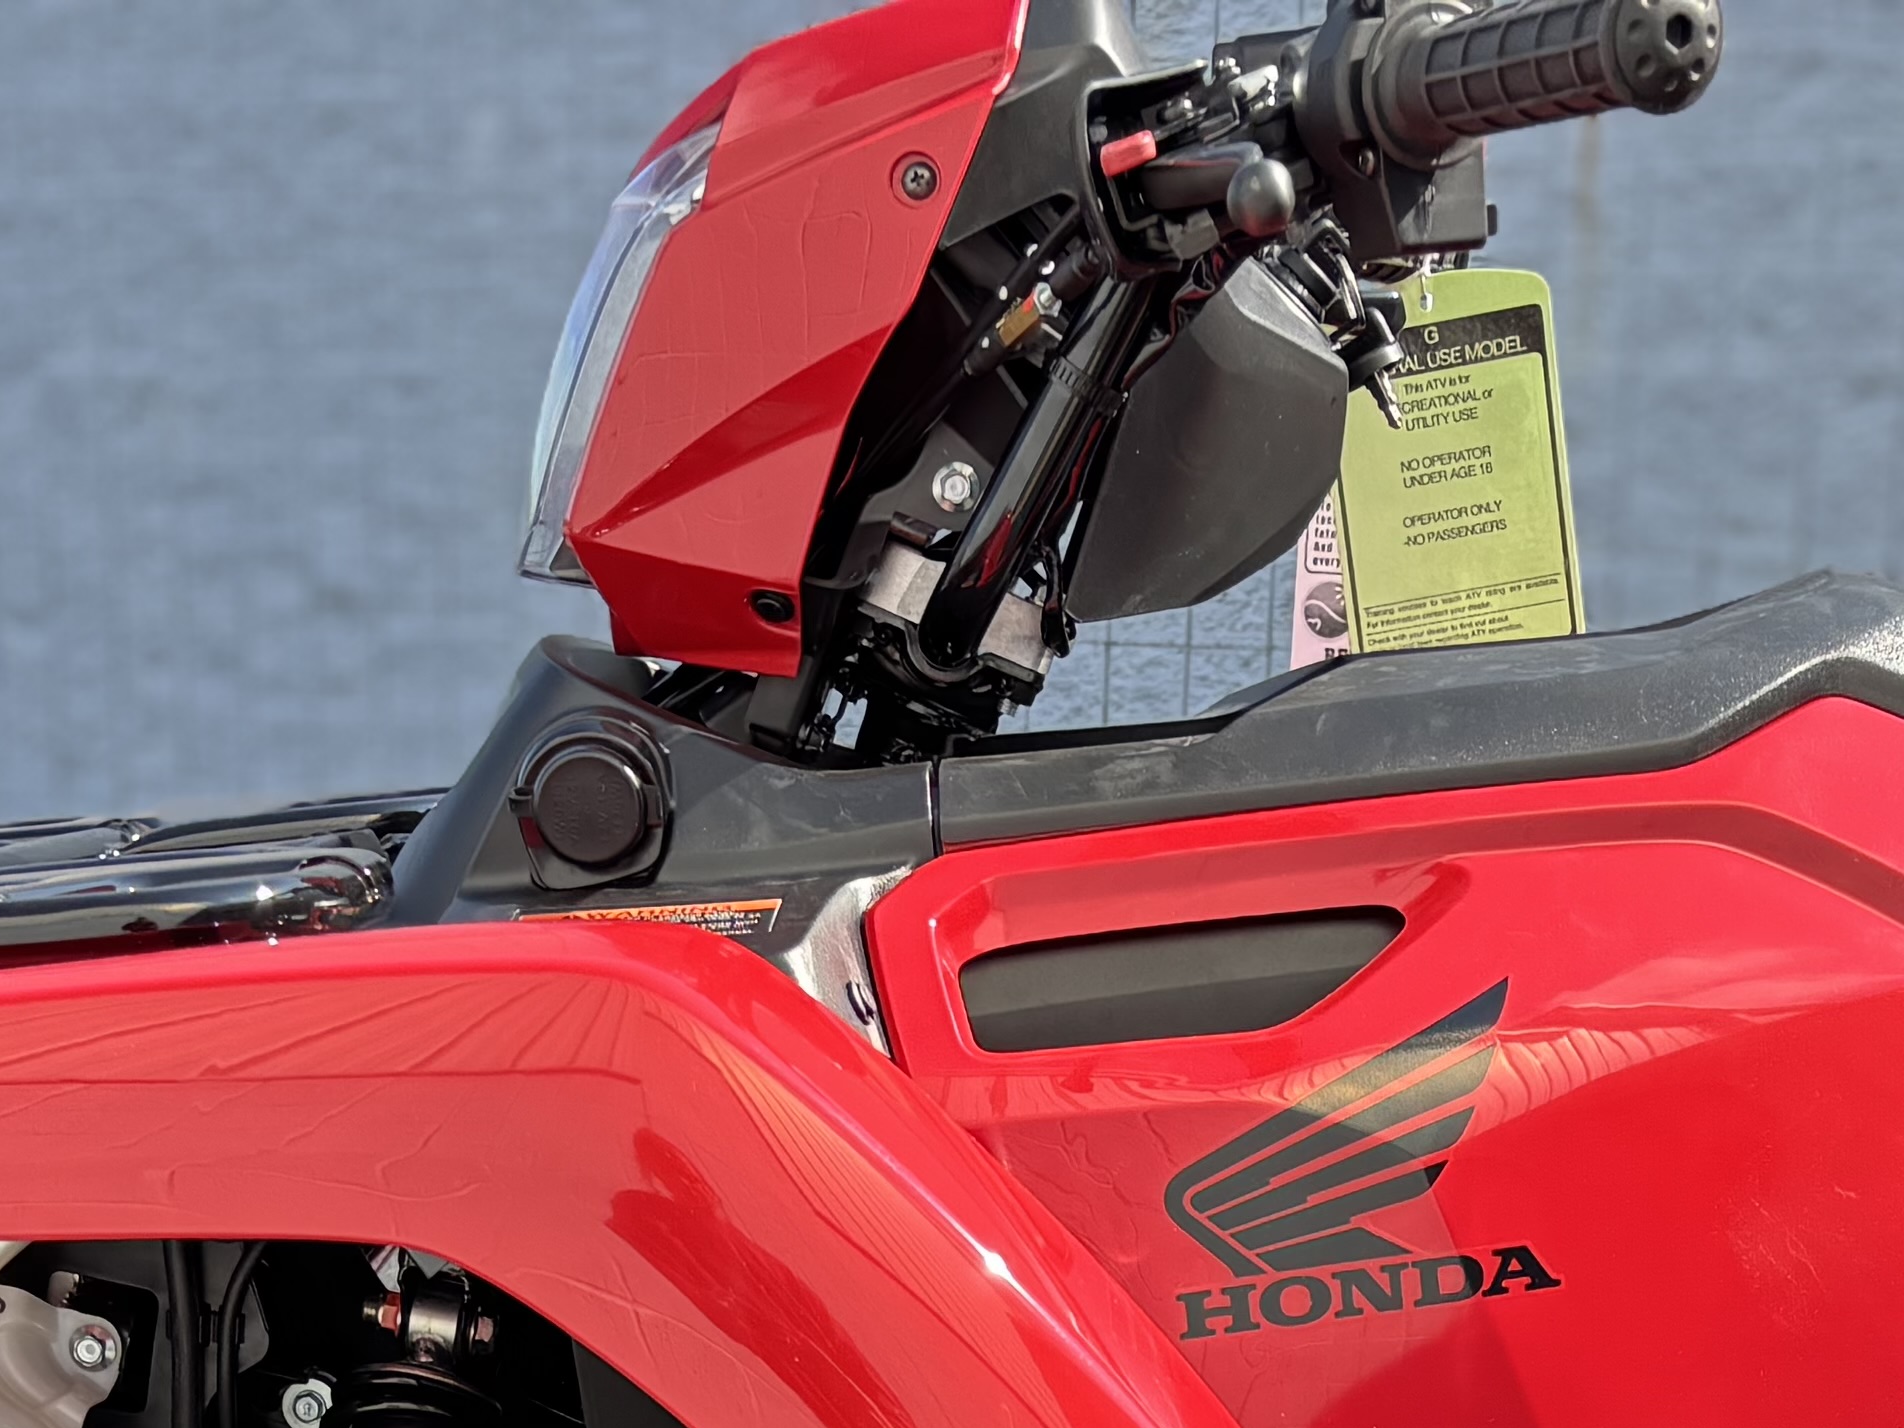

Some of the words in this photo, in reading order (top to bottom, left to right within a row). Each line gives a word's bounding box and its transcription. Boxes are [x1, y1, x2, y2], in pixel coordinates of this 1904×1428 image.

[1425, 345, 1463, 368] USE
[1463, 333, 1527, 361] MODEL
[1403, 381, 1424, 395] This
[1424, 377, 1447, 391] ATV
[1482, 388, 1494, 400] or
[1404, 412, 1451, 431] UTILITY
[1451, 406, 1479, 422] USE
[1399, 458, 1420, 473] NO
[1421, 444, 1492, 469] OPERATOR
[1402, 469, 1448, 488] UNDER
[1448, 464, 1477, 480] AGE
[1402, 505, 1469, 528] OPERATOR
[1469, 500, 1503, 516] ONLY
[1426, 518, 1507, 543] PASSENGERS
[1176, 1244, 1562, 1341] HONDA
